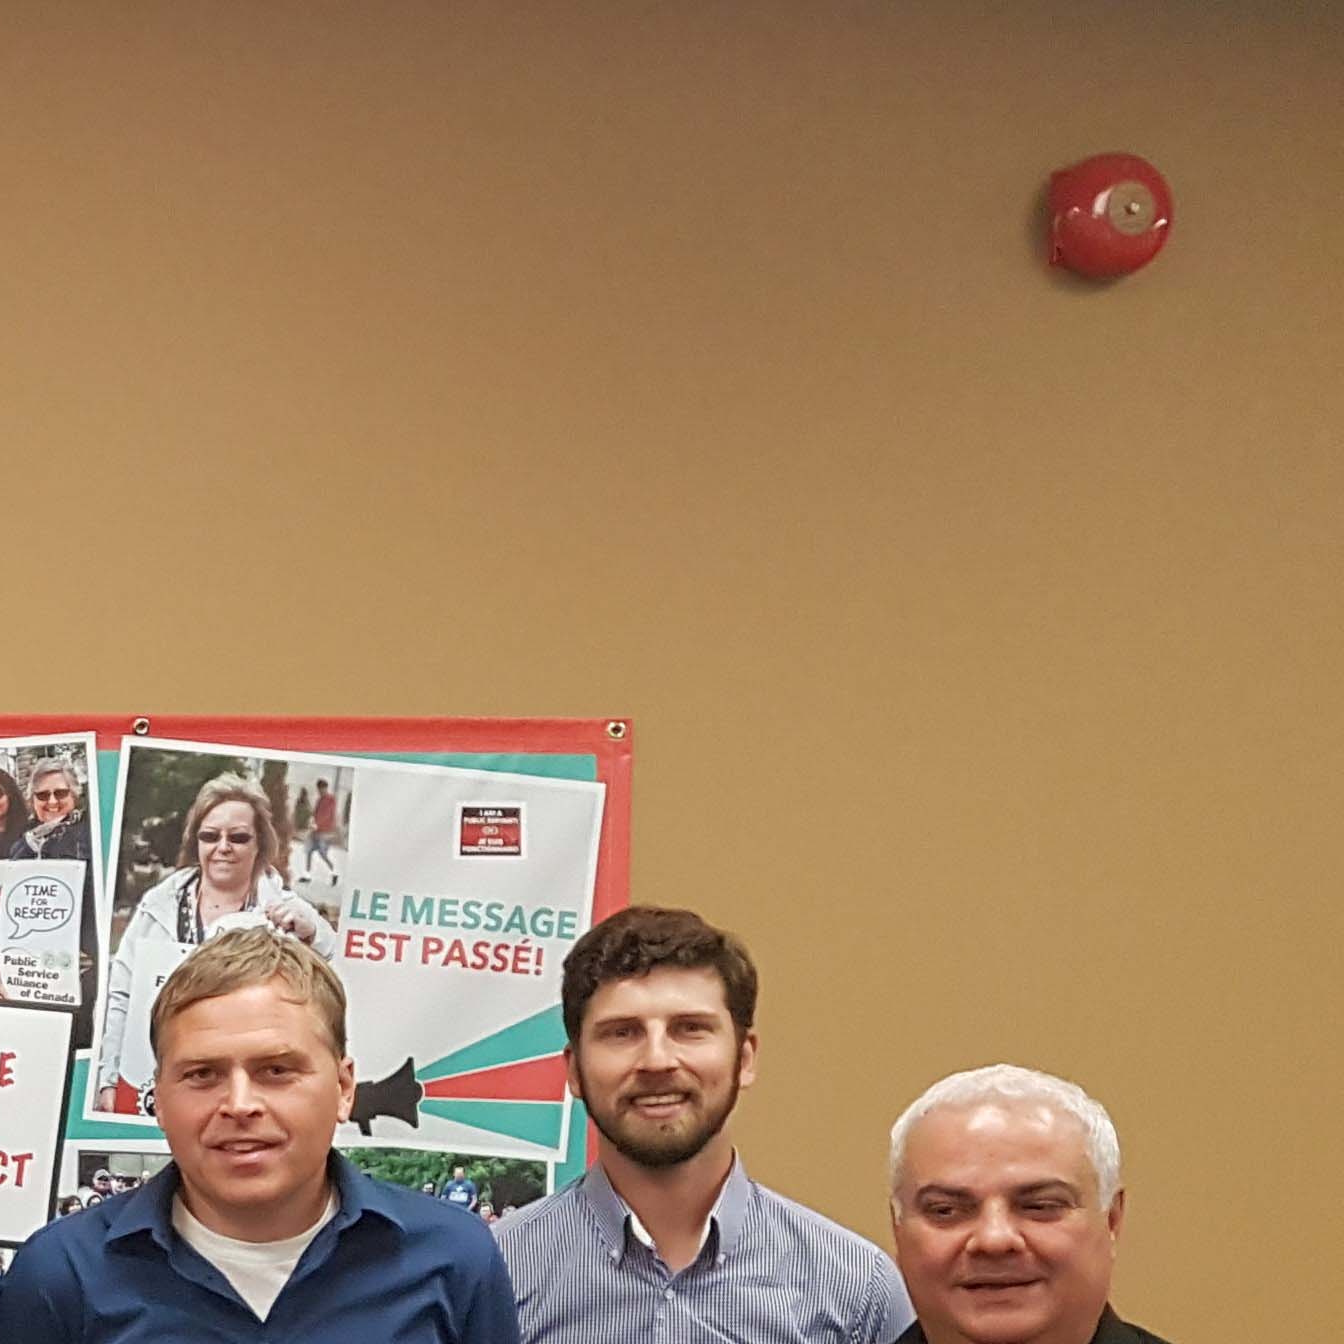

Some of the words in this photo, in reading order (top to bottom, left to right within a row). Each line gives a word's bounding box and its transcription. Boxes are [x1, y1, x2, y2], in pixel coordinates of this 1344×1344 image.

[24, 885, 59, 898] TIME
[31, 897, 48, 907] FOR
[14, 907, 69, 920] RESPECT
[349, 888, 391, 922] LE
[401, 895, 578, 940] MESSAGE
[344, 929, 411, 963] EST
[421, 936, 545, 977] PASSÉ!
[4, 956, 38, 967] Public
[18, 968, 60, 980] Service
[7, 978, 49, 990] Alliance
[20, 989, 31, 998] of
[34, 991, 75, 1004] Canada
